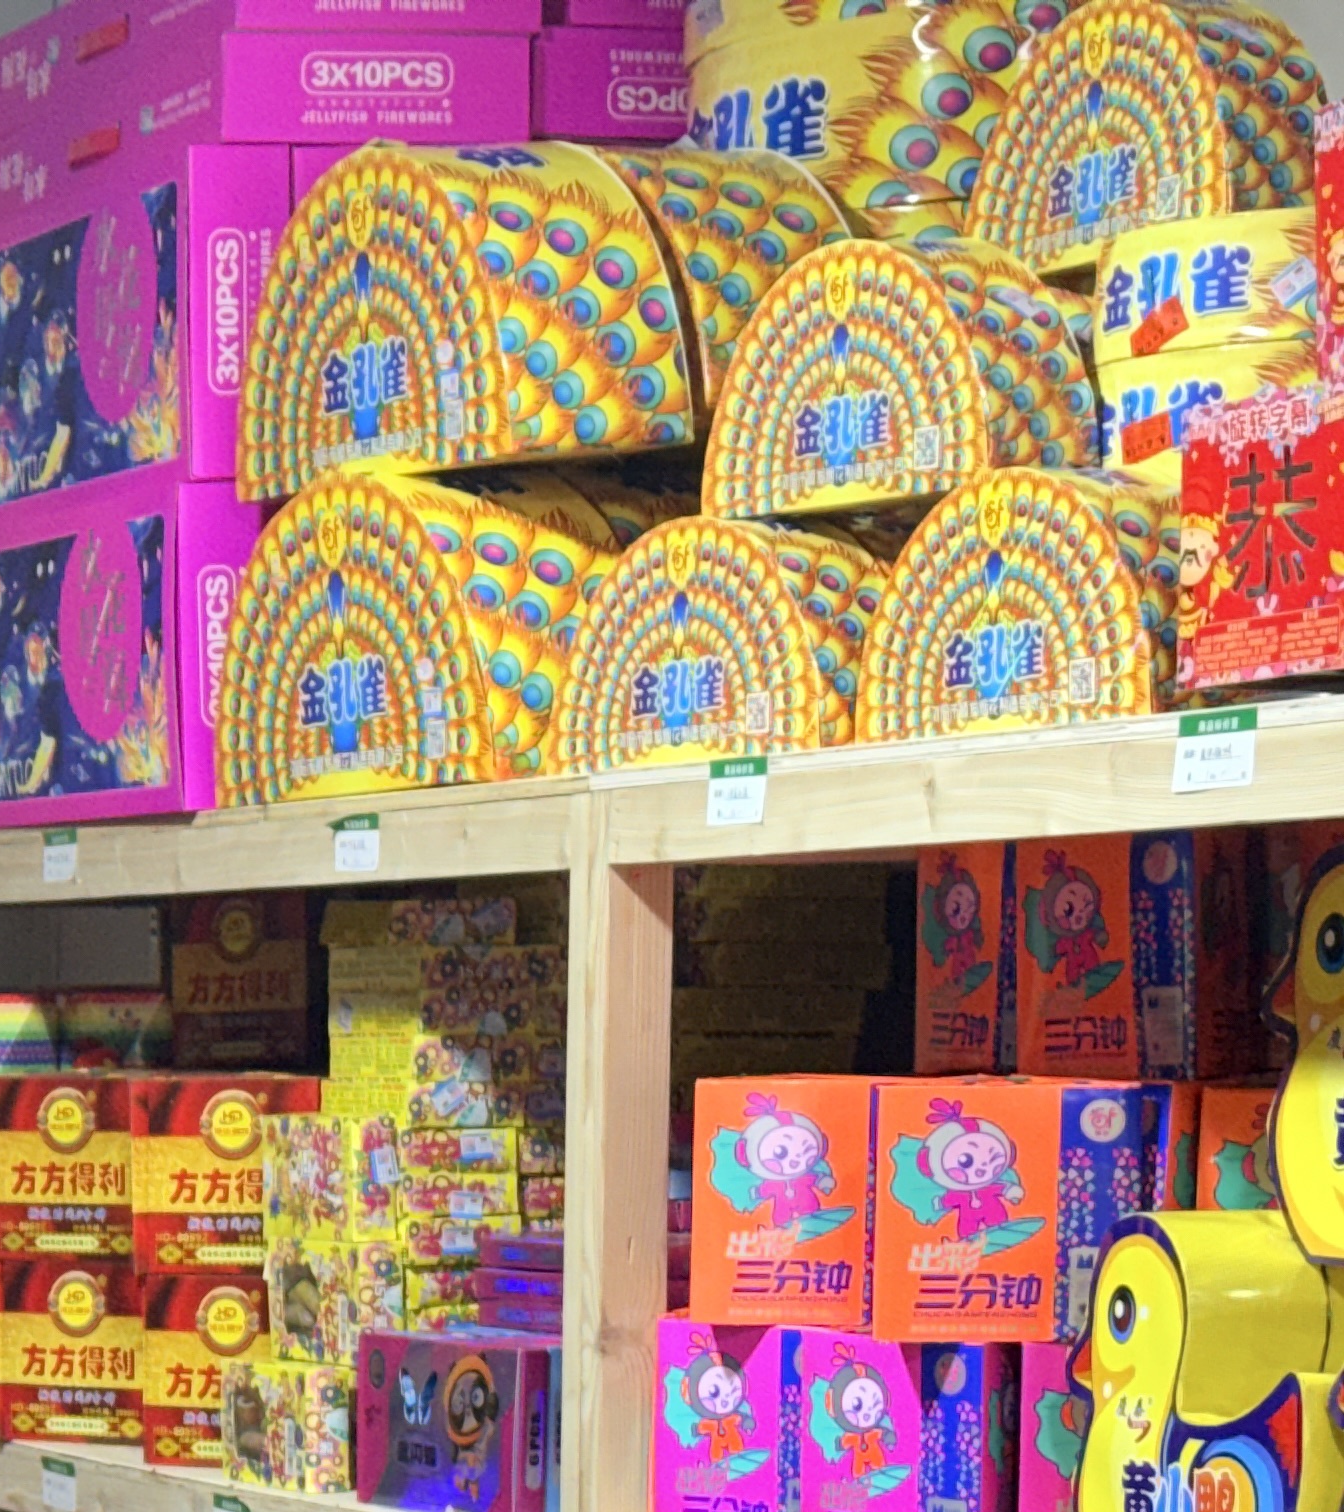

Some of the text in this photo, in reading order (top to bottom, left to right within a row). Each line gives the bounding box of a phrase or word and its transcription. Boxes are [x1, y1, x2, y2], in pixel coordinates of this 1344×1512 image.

[311, 60, 445, 88] 3X10PCS
[377, 110, 453, 124] FIREWORKS
[1048, 146, 1138, 221] 金孔雀
[215, 243, 241, 385] 3X10PCS
[321, 335, 409, 416] 金孔雀
[793, 388, 892, 460] 金孔雀
[1226, 445, 1317, 598] 恭
[942, 618, 1047, 690] 金孔雀
[297, 654, 387, 726] 金孔雀
[629, 655, 724, 719] 金孔雀
[1044, 1014, 1127, 1051] 三分钟
[10, 1160, 127, 1197] 方方得利
[169, 1166, 262, 1205] 方方得
[724, 1226, 802, 1260] 出彩
[908, 1236, 988, 1273] 出彩
[731, 1259, 853, 1295] 三分钟
[913, 1273, 1043, 1310] 三分钟
[21, 1342, 136, 1381] 方方得利
[165, 1362, 223, 1401] 方方
